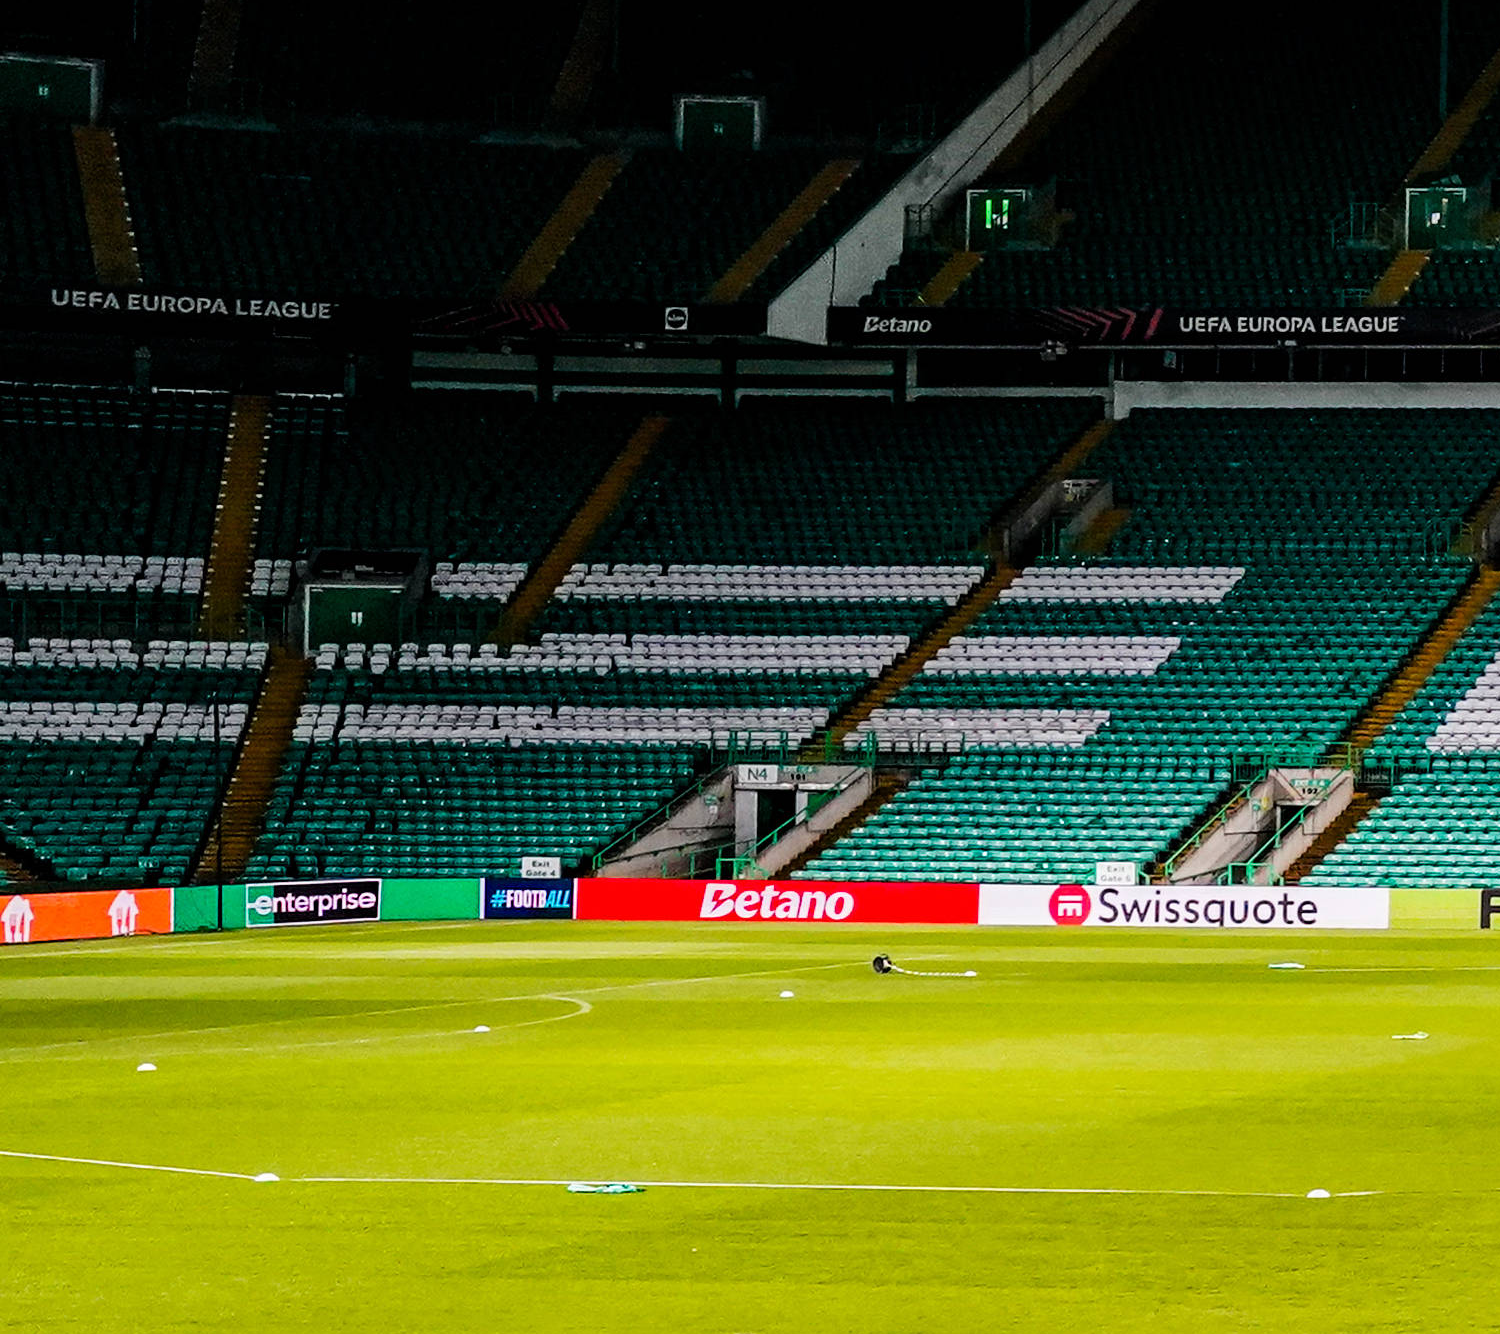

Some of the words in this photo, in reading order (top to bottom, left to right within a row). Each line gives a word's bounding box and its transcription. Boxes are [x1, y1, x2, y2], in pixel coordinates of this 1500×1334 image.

[52, 289, 120, 309] UEFA
[128, 294, 228, 315] EUROPA
[864, 316, 931, 333] Betano
[1180, 316, 1231, 333] UEFA
[1238, 316, 1316, 333] EUROPA
[747, 767, 768, 781] N4
[532, 860, 550, 868] Exit
[248, 888, 376, 918] enterprise
[491, 889, 571, 910] #FOOTBALL
[700, 883, 855, 920] Betano
[1098, 888, 1318, 927] Swissquote
